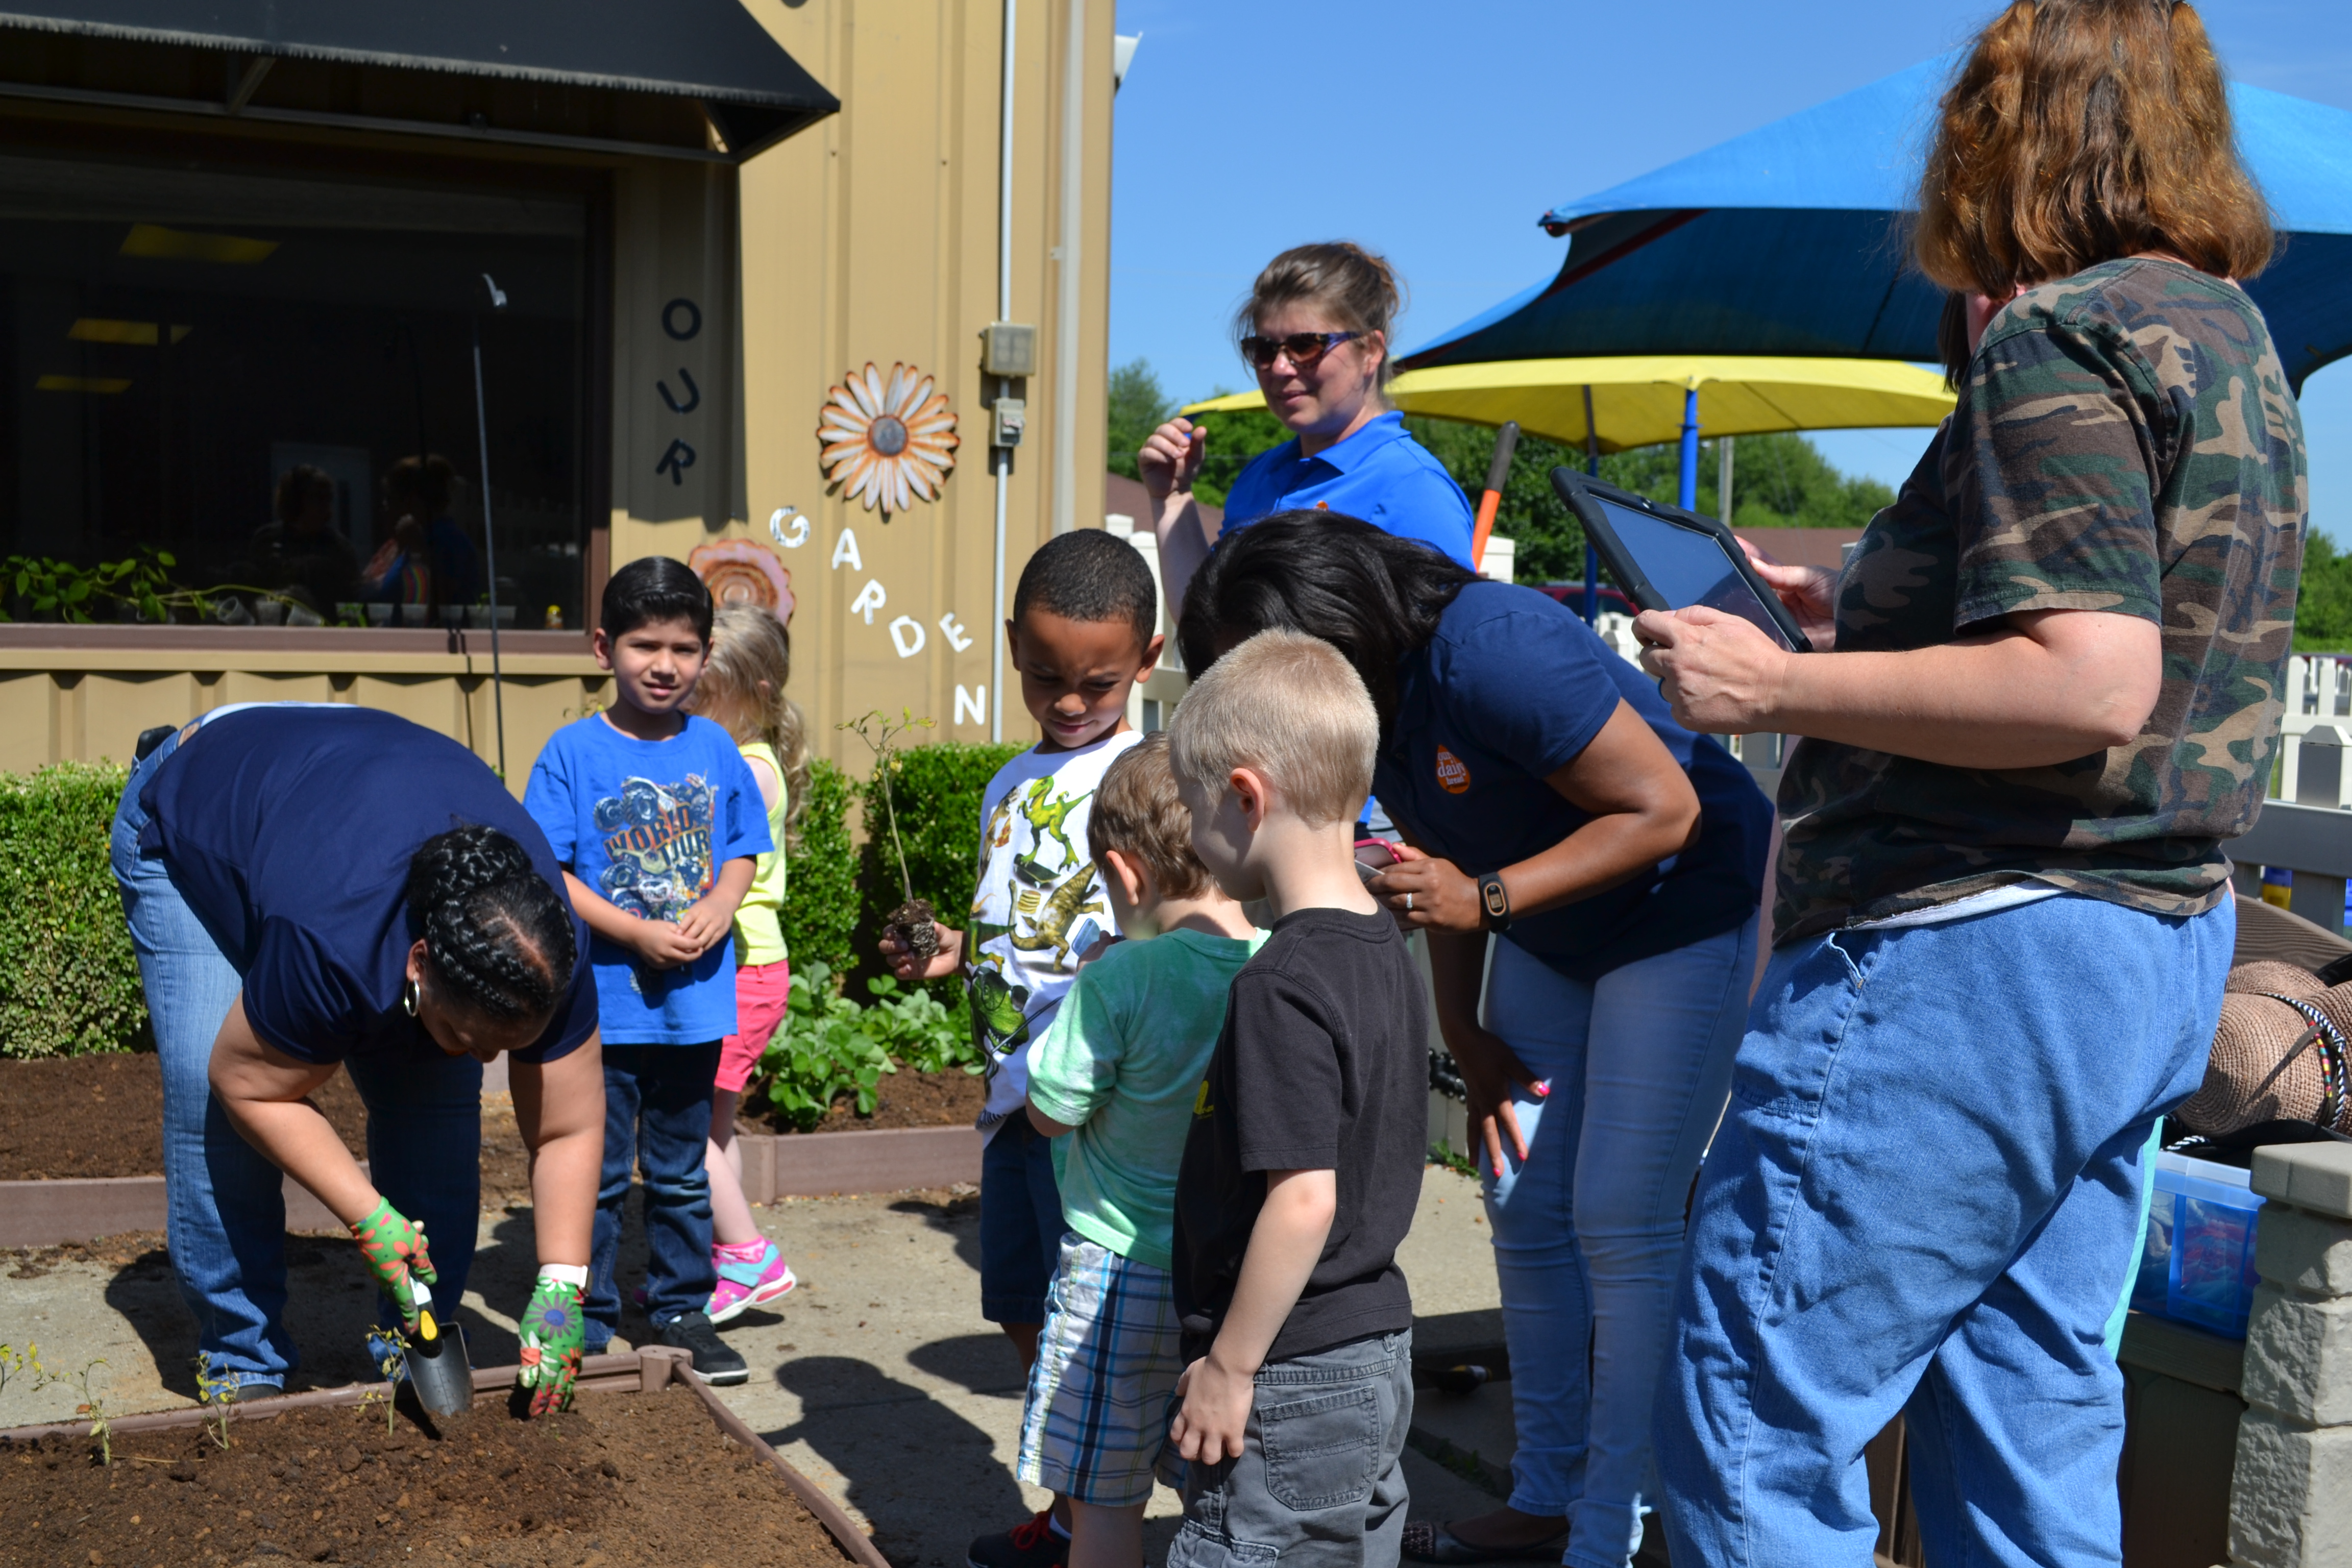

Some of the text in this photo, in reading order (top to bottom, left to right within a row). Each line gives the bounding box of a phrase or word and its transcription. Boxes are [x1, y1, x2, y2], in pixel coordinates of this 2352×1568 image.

[656, 298, 702, 486] OUR
[770, 505, 986, 725] GARDEN
[1437, 757, 1466, 777] daily
[603, 804, 694, 863] WORLD
[656, 828, 709, 866] TOUR
